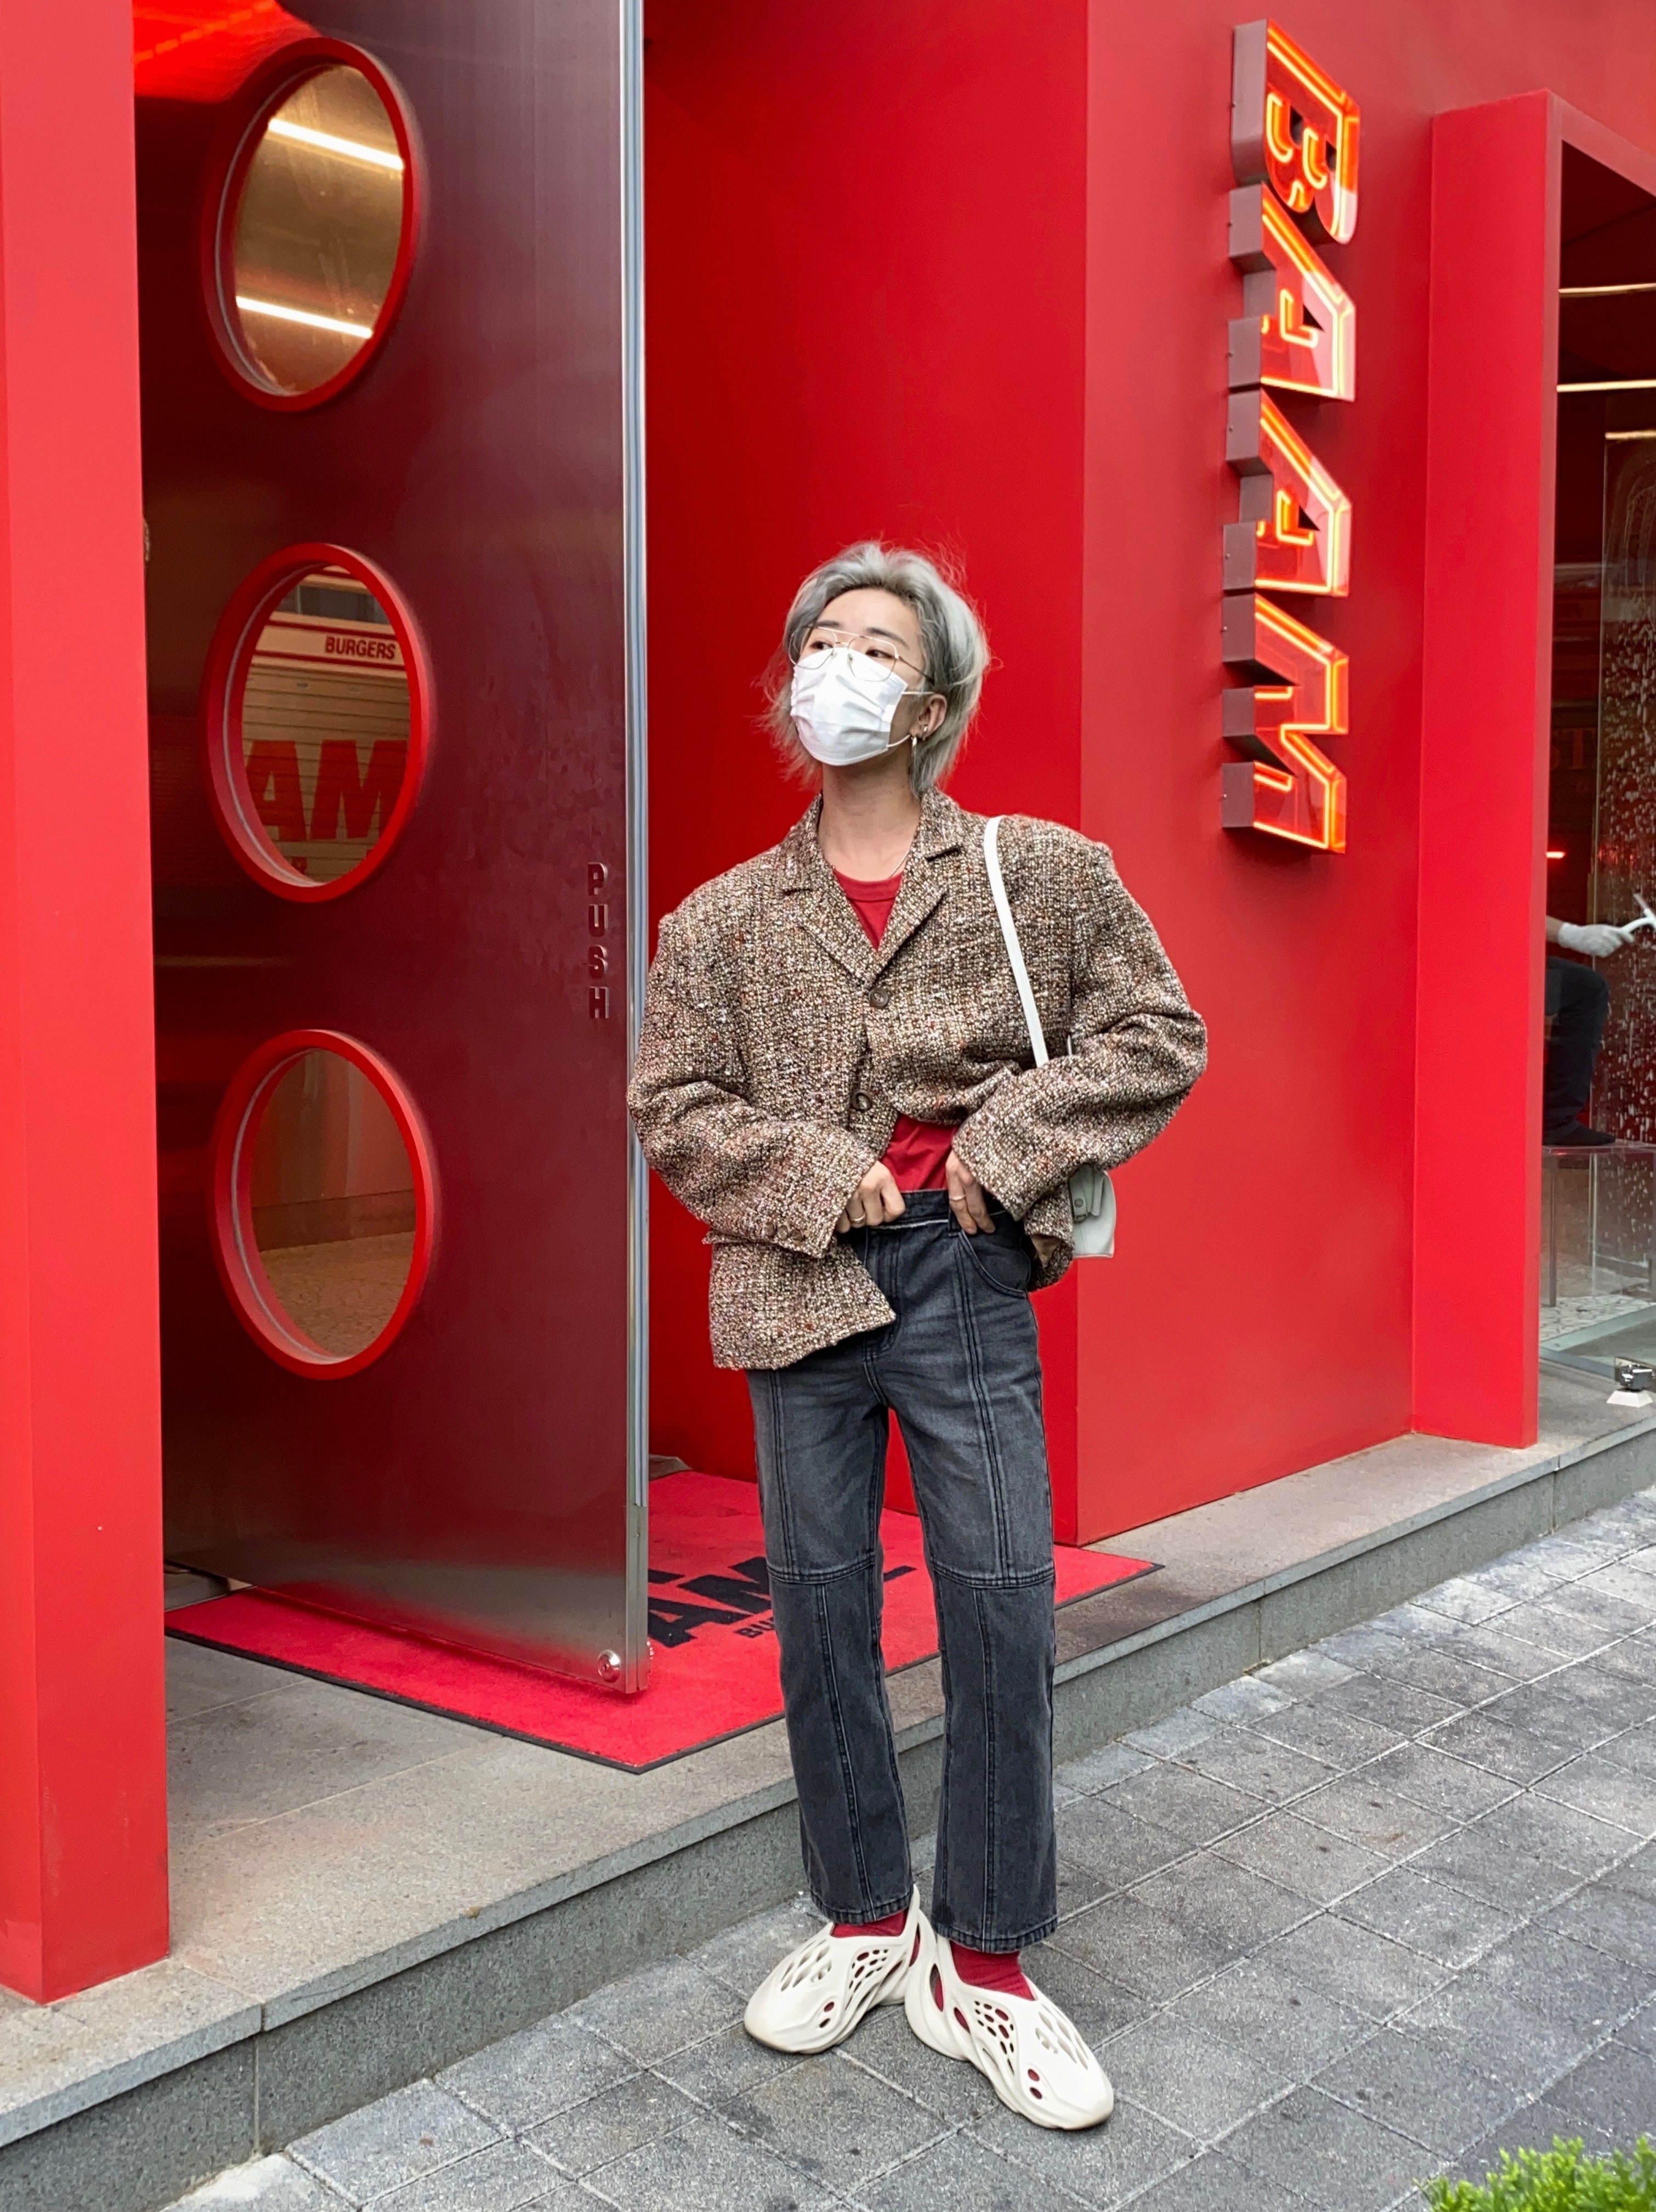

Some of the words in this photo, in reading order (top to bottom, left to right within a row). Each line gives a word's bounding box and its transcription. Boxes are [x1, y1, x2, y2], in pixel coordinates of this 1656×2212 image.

[1226, 18, 1360, 854] BAAM
[324, 635, 396, 660] BURGERS
[245, 739, 407, 841] AM
[587, 862, 610, 1019] PUSH
